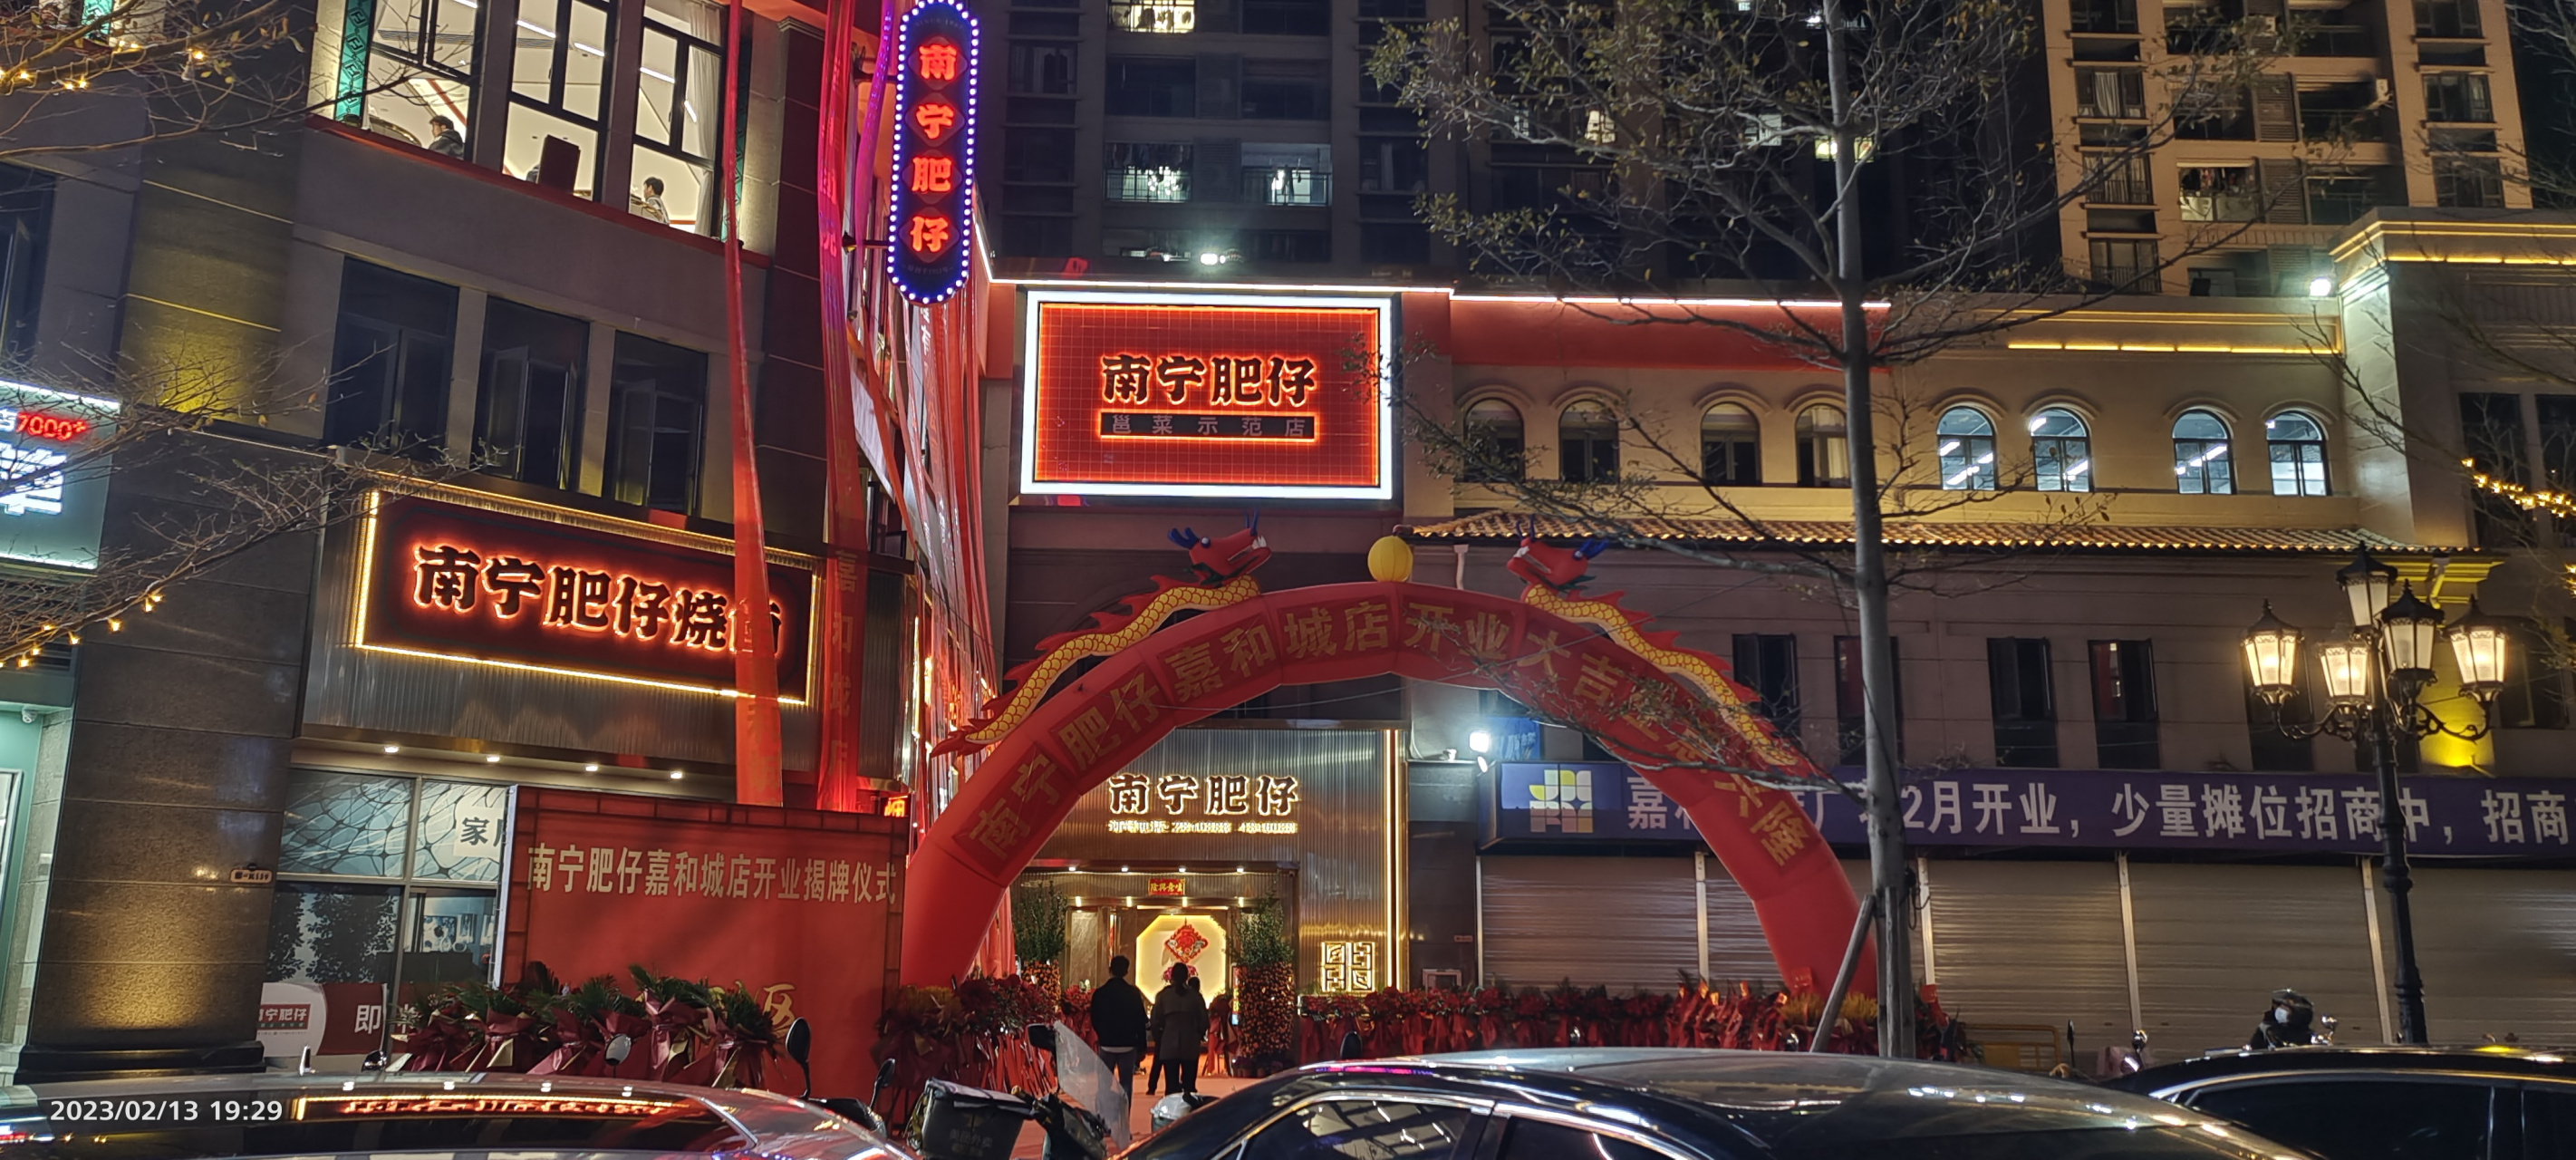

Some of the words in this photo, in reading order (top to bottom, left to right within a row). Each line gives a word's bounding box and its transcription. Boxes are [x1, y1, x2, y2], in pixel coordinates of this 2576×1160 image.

[910, 44, 958, 253] 南宁肥仔
[1102, 354, 1316, 406] 南宁肥仔
[1112, 414, 1306, 437] 邕菜示范店
[1108, 773, 1299, 817] 南宁肥仔
[527, 842, 897, 904] 南宁肥仔嘉和城店开业揭牌仪式
